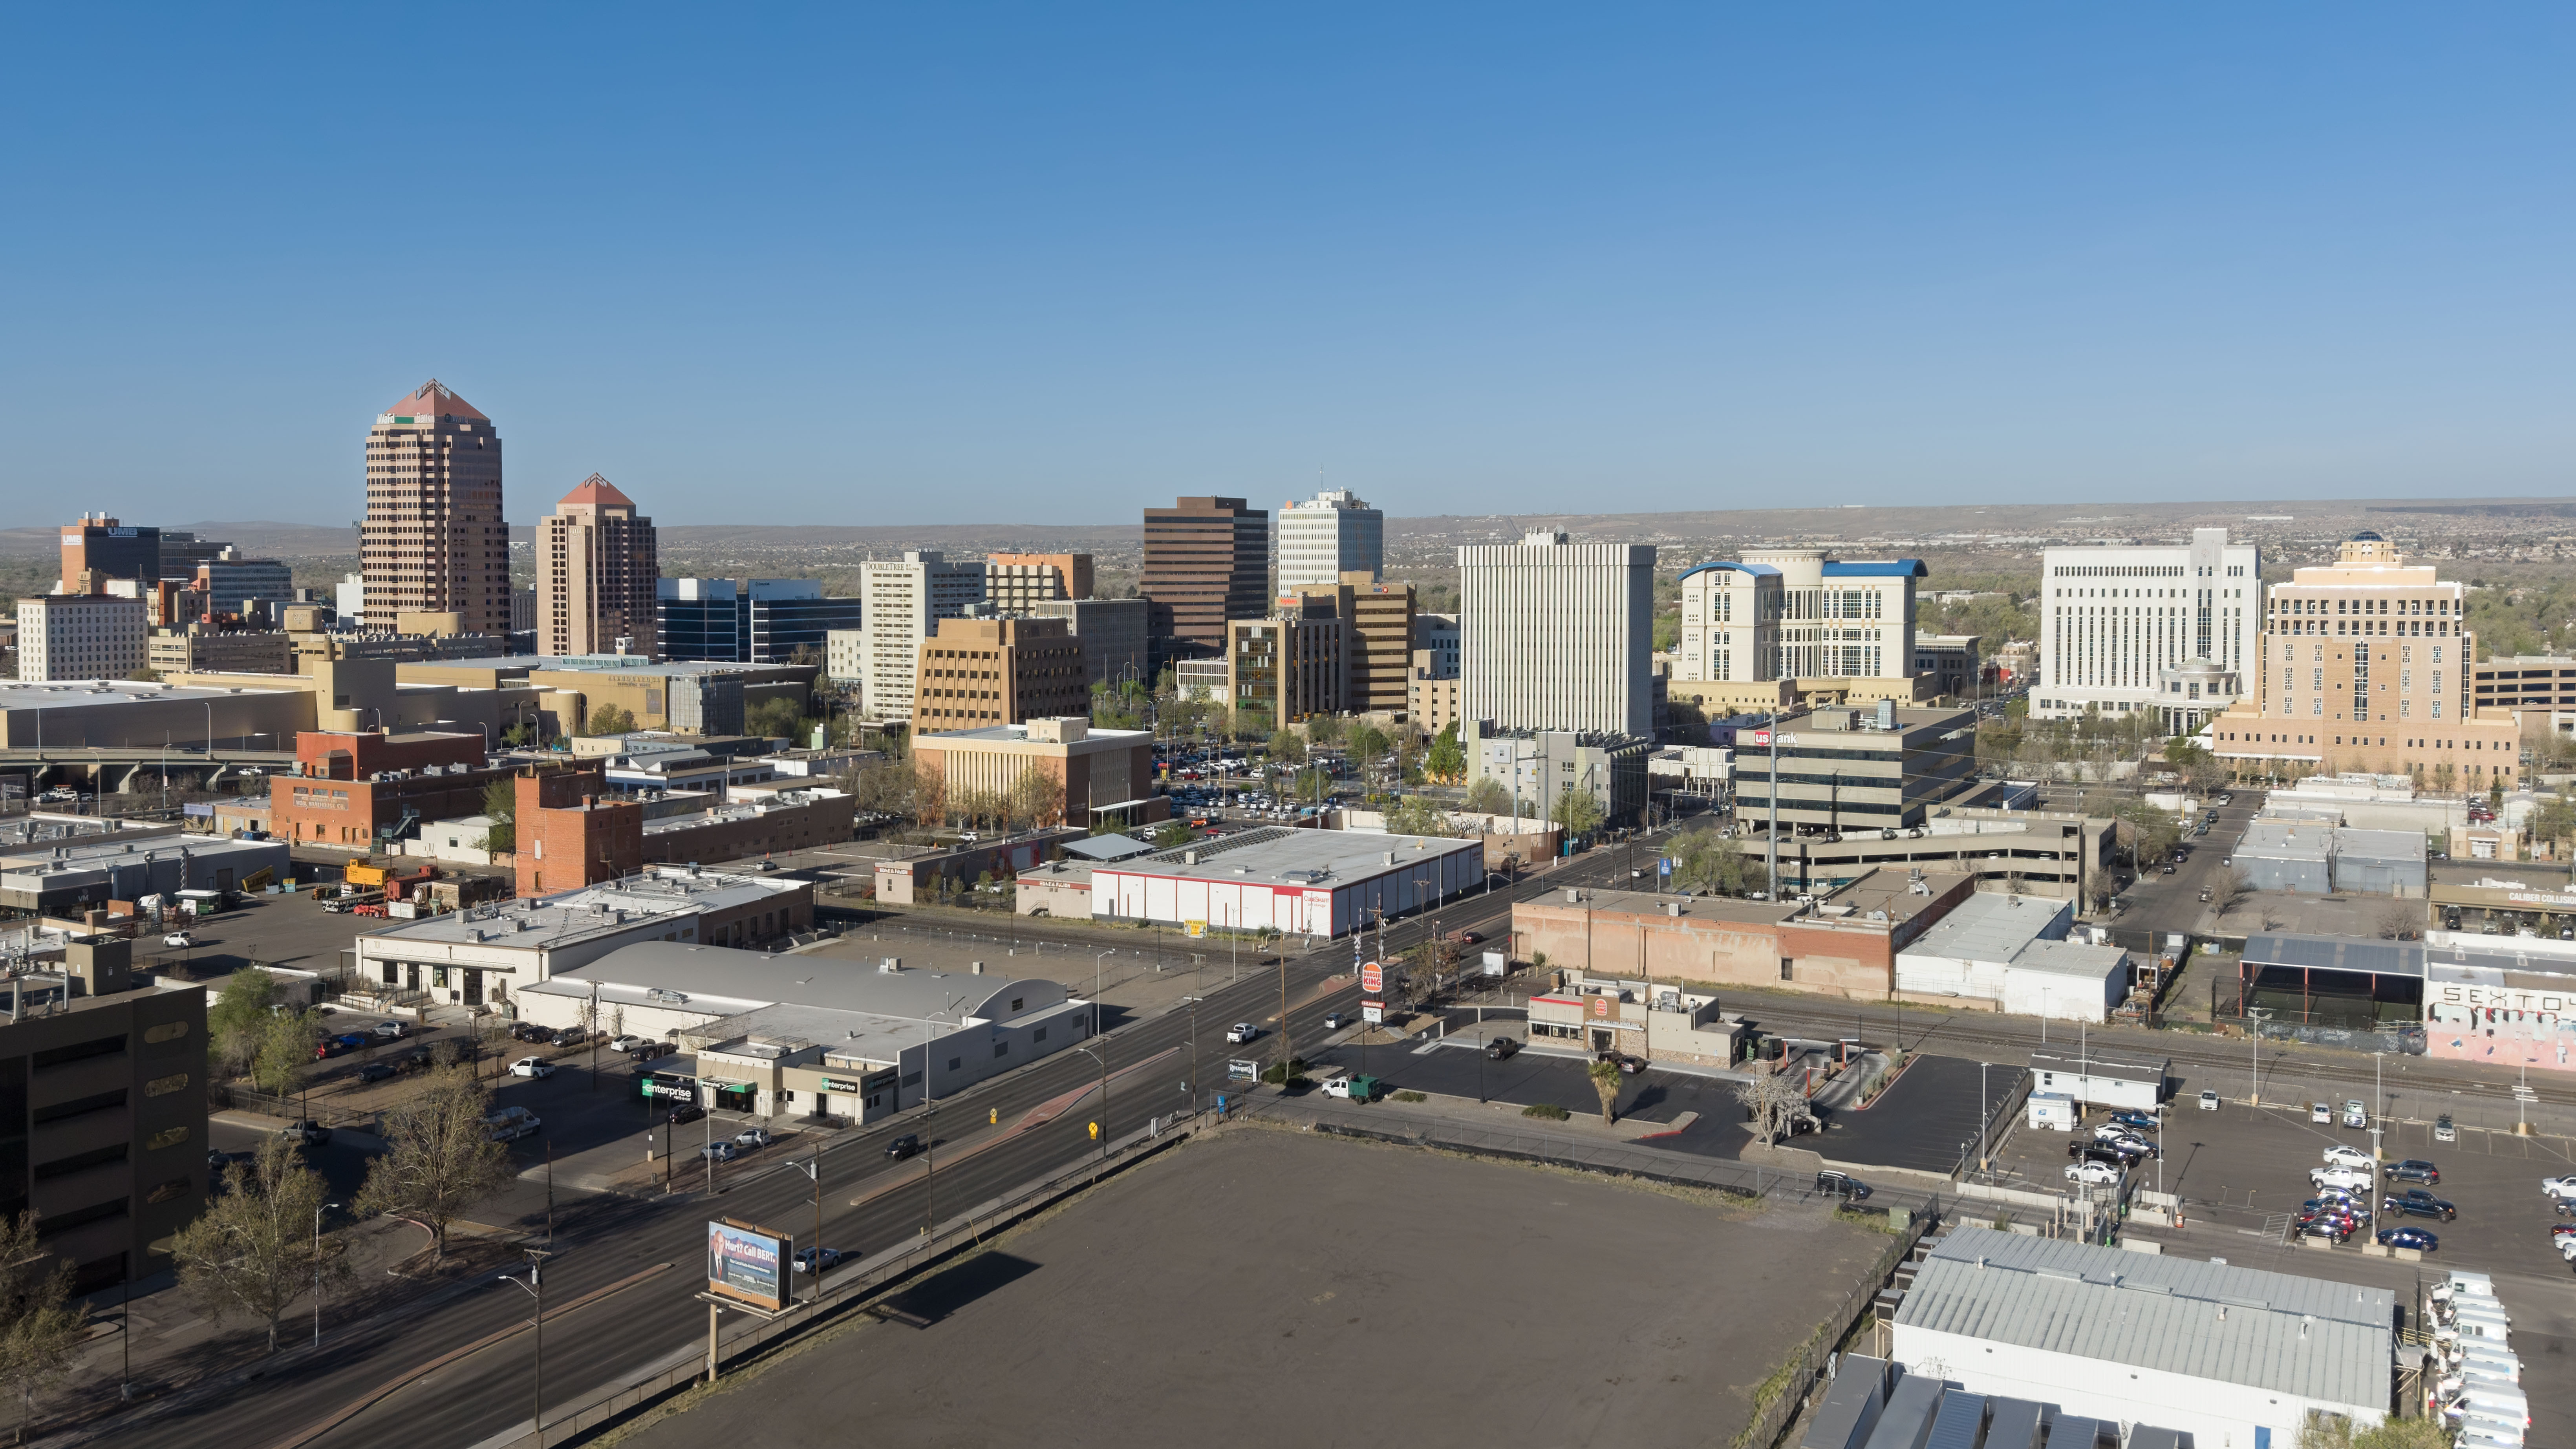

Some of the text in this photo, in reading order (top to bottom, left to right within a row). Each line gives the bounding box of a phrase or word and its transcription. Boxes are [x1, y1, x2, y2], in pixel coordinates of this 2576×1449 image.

[377, 412, 431, 423] WaFd Bank
[108, 527, 137, 536] UMB
[62, 535, 82, 543] UMB
[2509, 892, 2576, 904] CALIBER COLLISIO
[1363, 977, 1381, 986] KING
[645, 1084, 691, 1098] enterprise
[823, 1081, 856, 1091] enterprise
[725, 1240, 776, 1263] Hurt? Call BERT.
